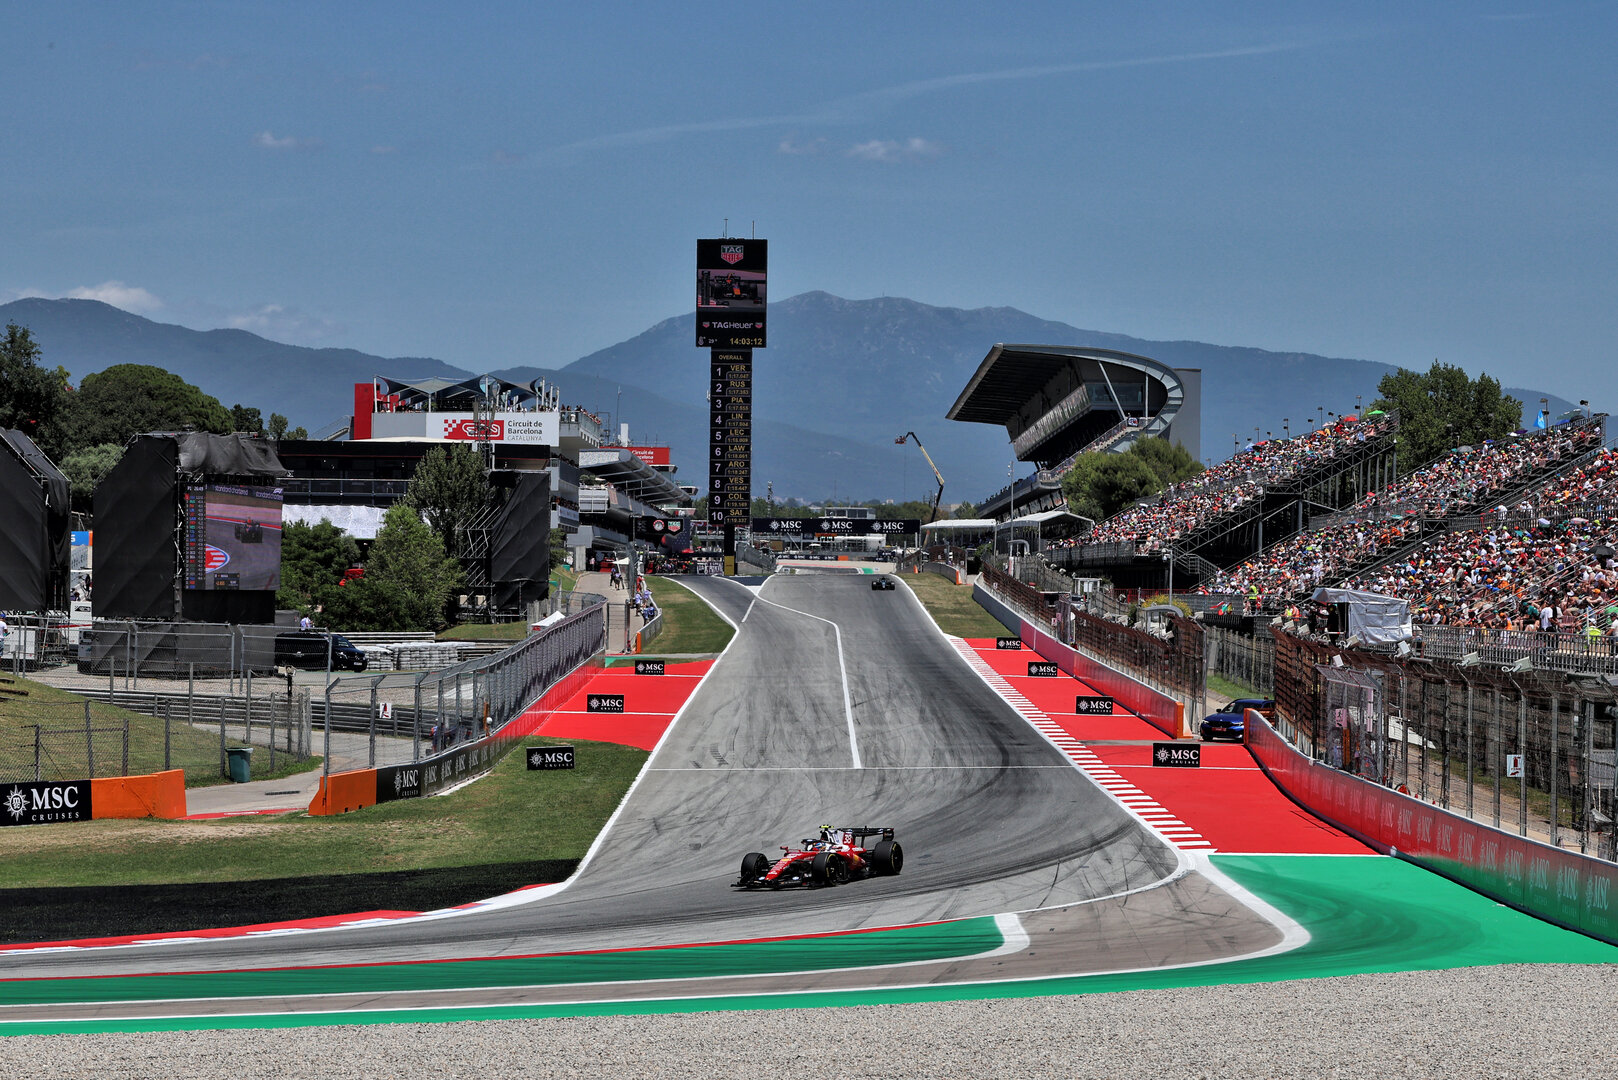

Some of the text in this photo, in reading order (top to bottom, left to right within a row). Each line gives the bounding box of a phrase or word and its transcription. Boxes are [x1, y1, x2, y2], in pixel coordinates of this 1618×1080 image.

[716, 368, 721, 376] 1
[716, 384, 722, 392] 2
[716, 400, 722, 408] 3
[716, 416, 722, 424] 4
[716, 432, 722, 440] 5
[715, 448, 721, 456] 6
[715, 464, 721, 472] 7
[715, 480, 720, 488] 8
[714, 496, 720, 504] 9
[712, 512, 723, 520] 10
[601, 699, 623, 707] MSC
[1090, 701, 1112, 709] MSC
[545, 753, 572, 762] MSC
[1171, 750, 1199, 759] MSC
[402, 770, 418, 787] MSC
[31, 786, 78, 810] MSC
[32, 812, 79, 821] CRUISES
[1563, 865, 1578, 900] MSC
[1593, 875, 1610, 910] MSC
